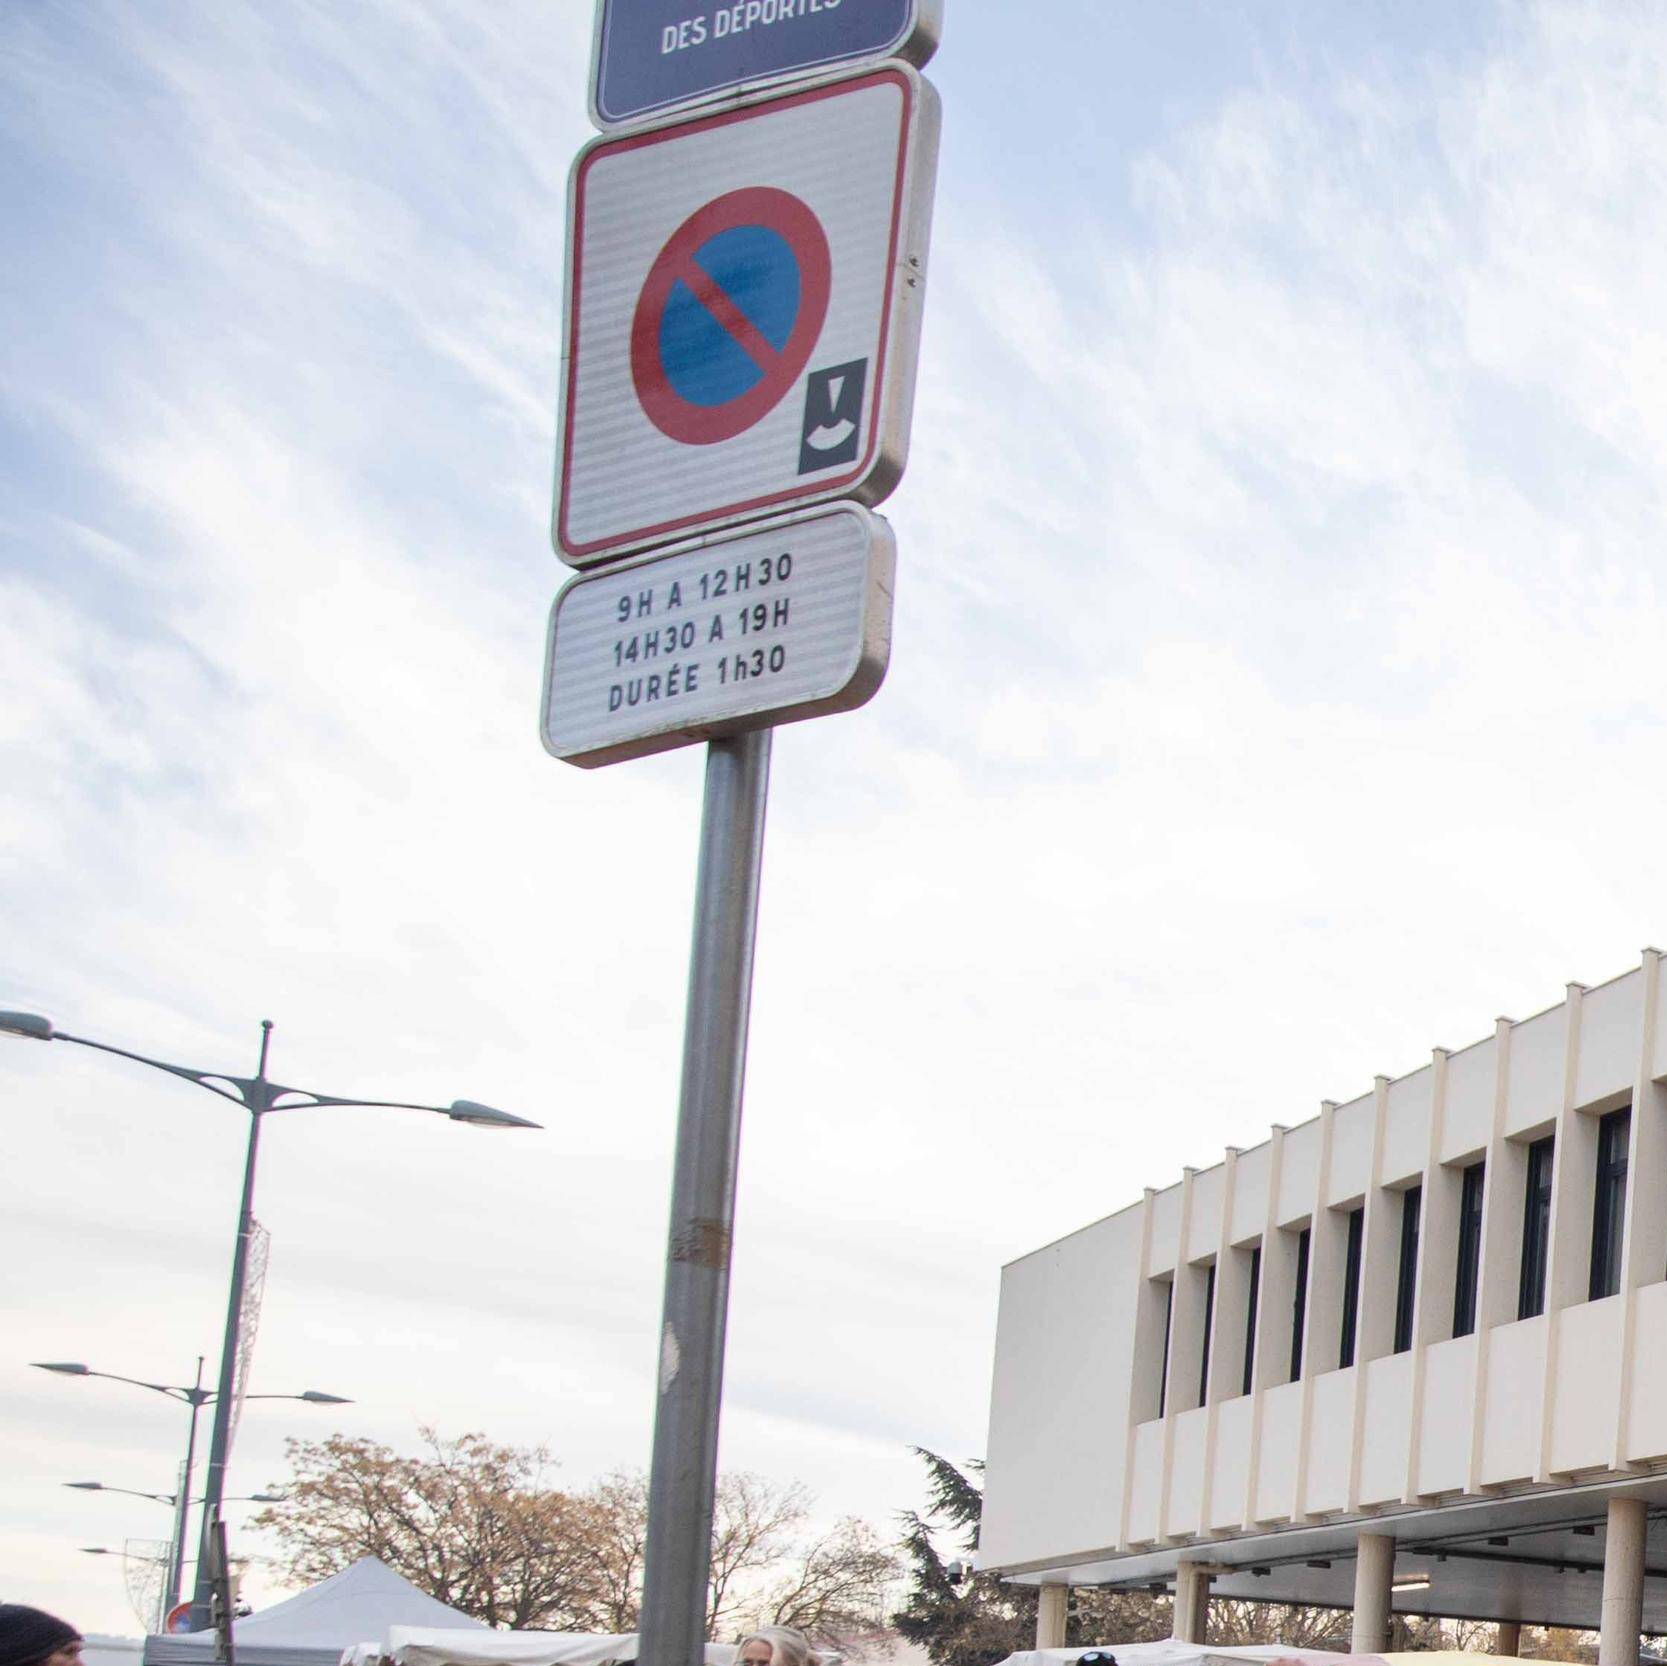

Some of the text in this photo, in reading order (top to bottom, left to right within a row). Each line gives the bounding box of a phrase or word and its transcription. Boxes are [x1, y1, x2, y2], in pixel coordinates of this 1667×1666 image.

[661, 16, 707, 54] DES
[618, 553, 792, 622] 9H A 12H30
[614, 598, 790, 667] 14H30 A 19H
[609, 645, 785, 712] DURÉE 1h30
